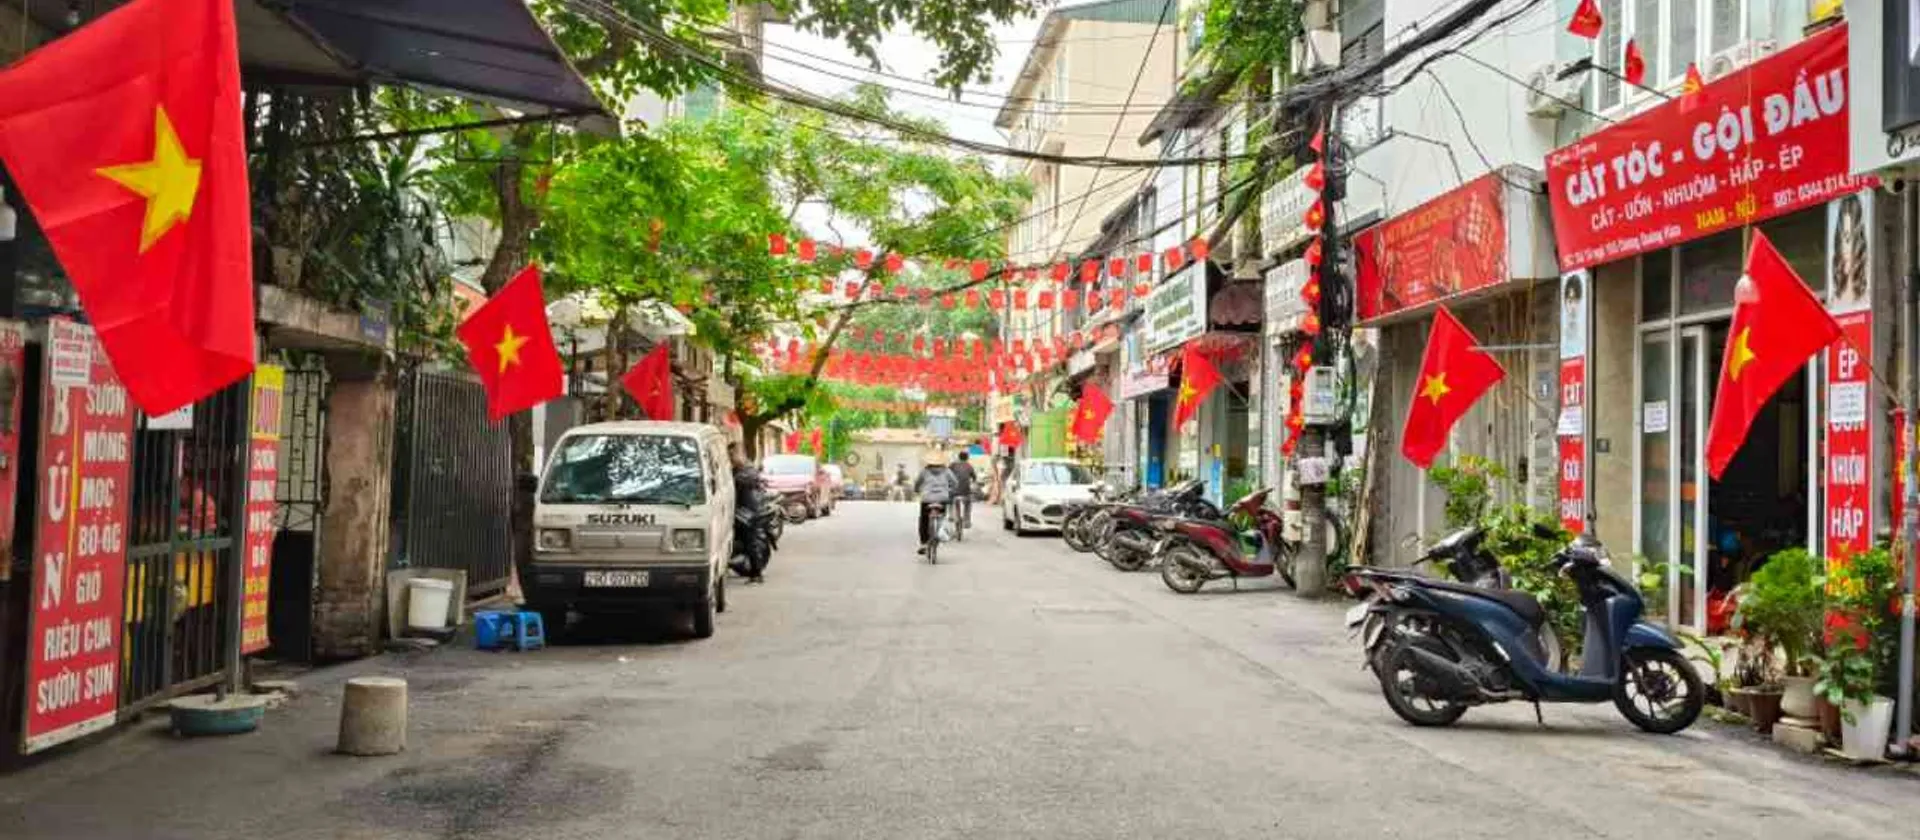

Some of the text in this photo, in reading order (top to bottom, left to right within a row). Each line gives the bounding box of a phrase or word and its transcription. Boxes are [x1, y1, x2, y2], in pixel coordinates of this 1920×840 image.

[1566, 157, 1606, 206] CẮT
[1612, 140, 1664, 190] TÓC
[1672, 149, 1684, 163] -
[1692, 104, 1754, 160] GỘI
[1763, 68, 1844, 136] ĐẦU
[1591, 204, 1616, 231] CẮT
[1624, 191, 1653, 220] UỐN
[1663, 173, 1718, 209] NHUỘM
[1729, 153, 1764, 187] HẤP
[1778, 144, 1804, 171] ÉP
[1696, 207, 1726, 229] NAM
[1735, 193, 1757, 219] NỮ
[1838, 342, 1859, 379] ÉP
[85, 378, 126, 418] SƯỜN
[83, 425, 126, 462] MÓNG
[80, 477, 115, 513] MỌC
[587, 513, 656, 525] SUZUKI
[1831, 496, 1865, 538] HẤP
[44, 615, 112, 661] RIÊU CUA
[36, 661, 115, 714] SƯỜN SỤN
